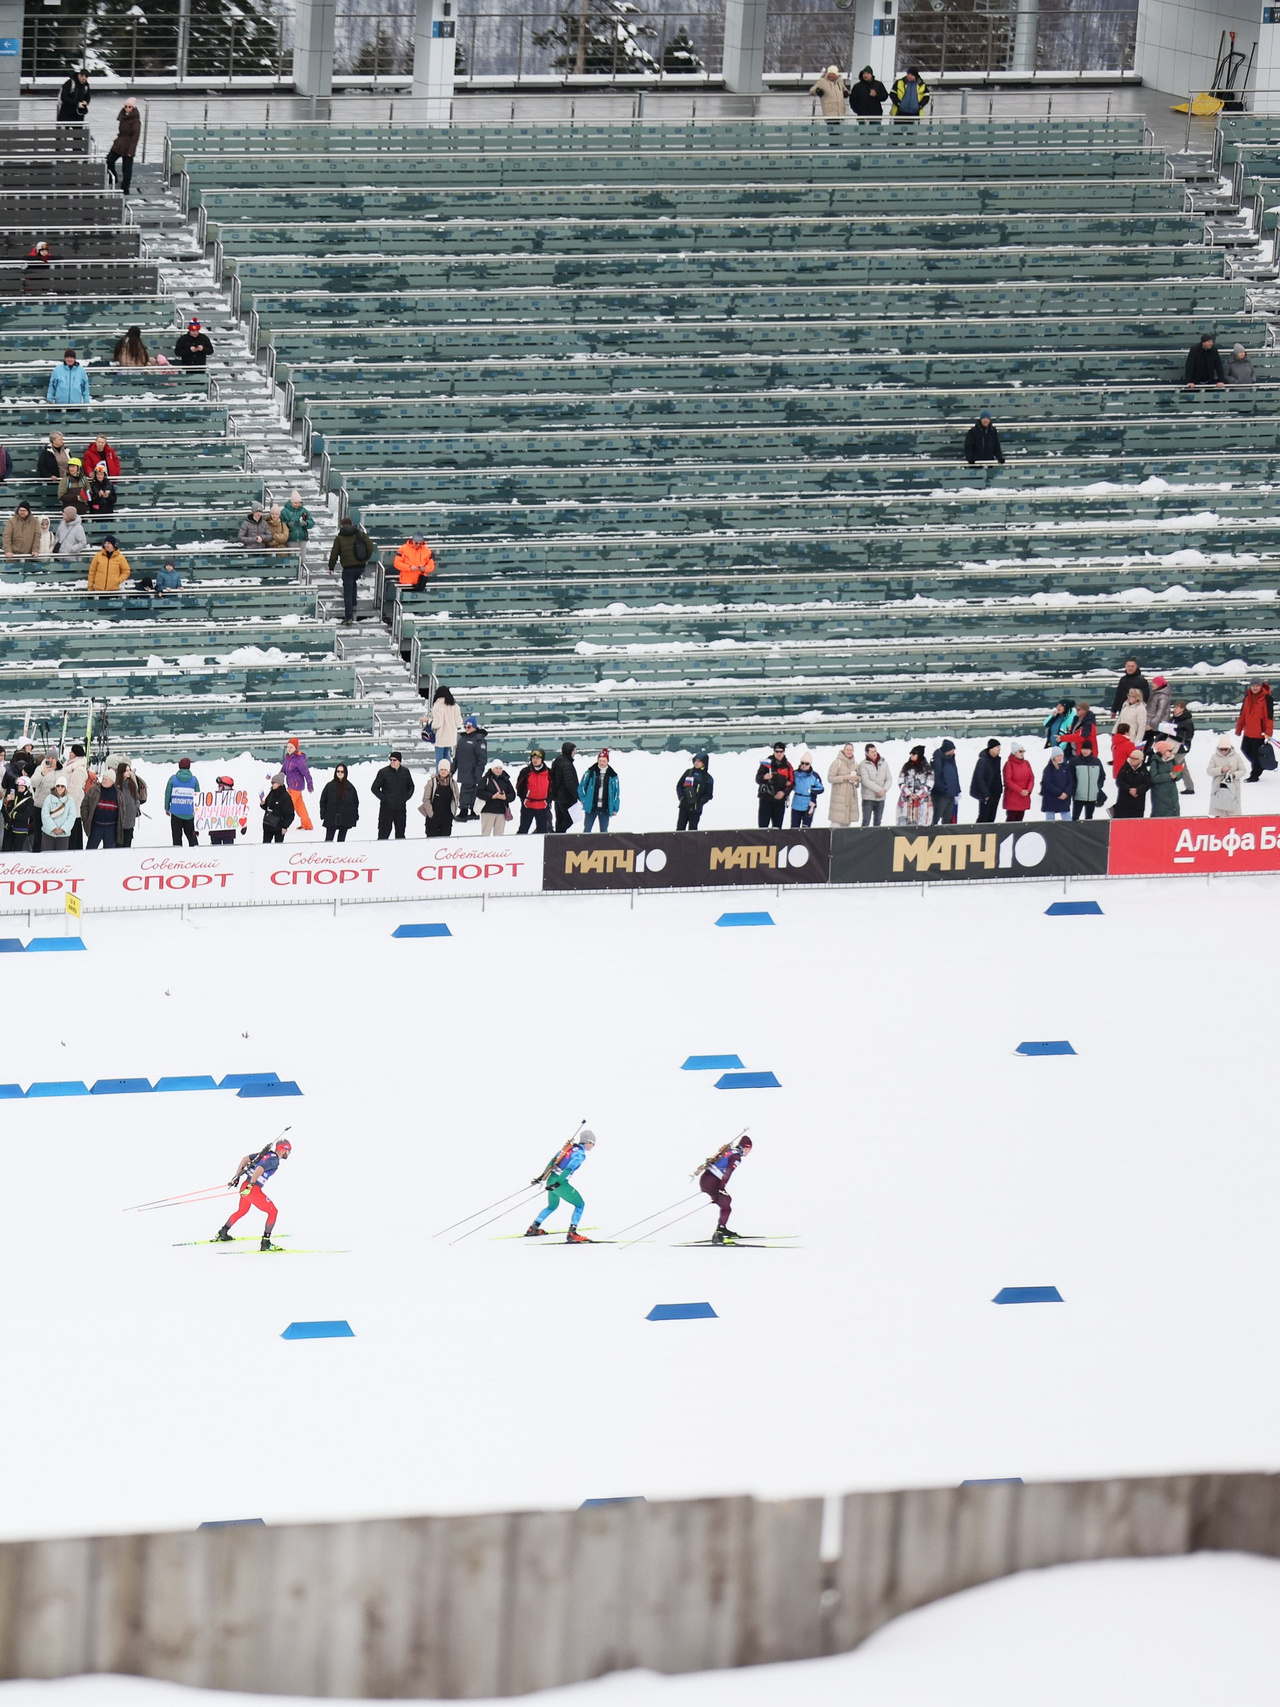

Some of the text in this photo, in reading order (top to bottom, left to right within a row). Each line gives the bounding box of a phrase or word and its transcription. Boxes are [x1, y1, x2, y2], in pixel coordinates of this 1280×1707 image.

[195, 790, 249, 807] ЛОГИНОВ
[196, 816, 239, 831] САРАТОВ
[1175, 826, 1280, 858] Альфа Б
[288, 852, 368, 866] Советский
[434, 847, 513, 861] Советский
[140, 857, 222, 871] Советский
[416, 862, 525, 881] СПОРТ
[122, 873, 234, 891] СПОРТ
[270, 868, 380, 886] СПОРТ
